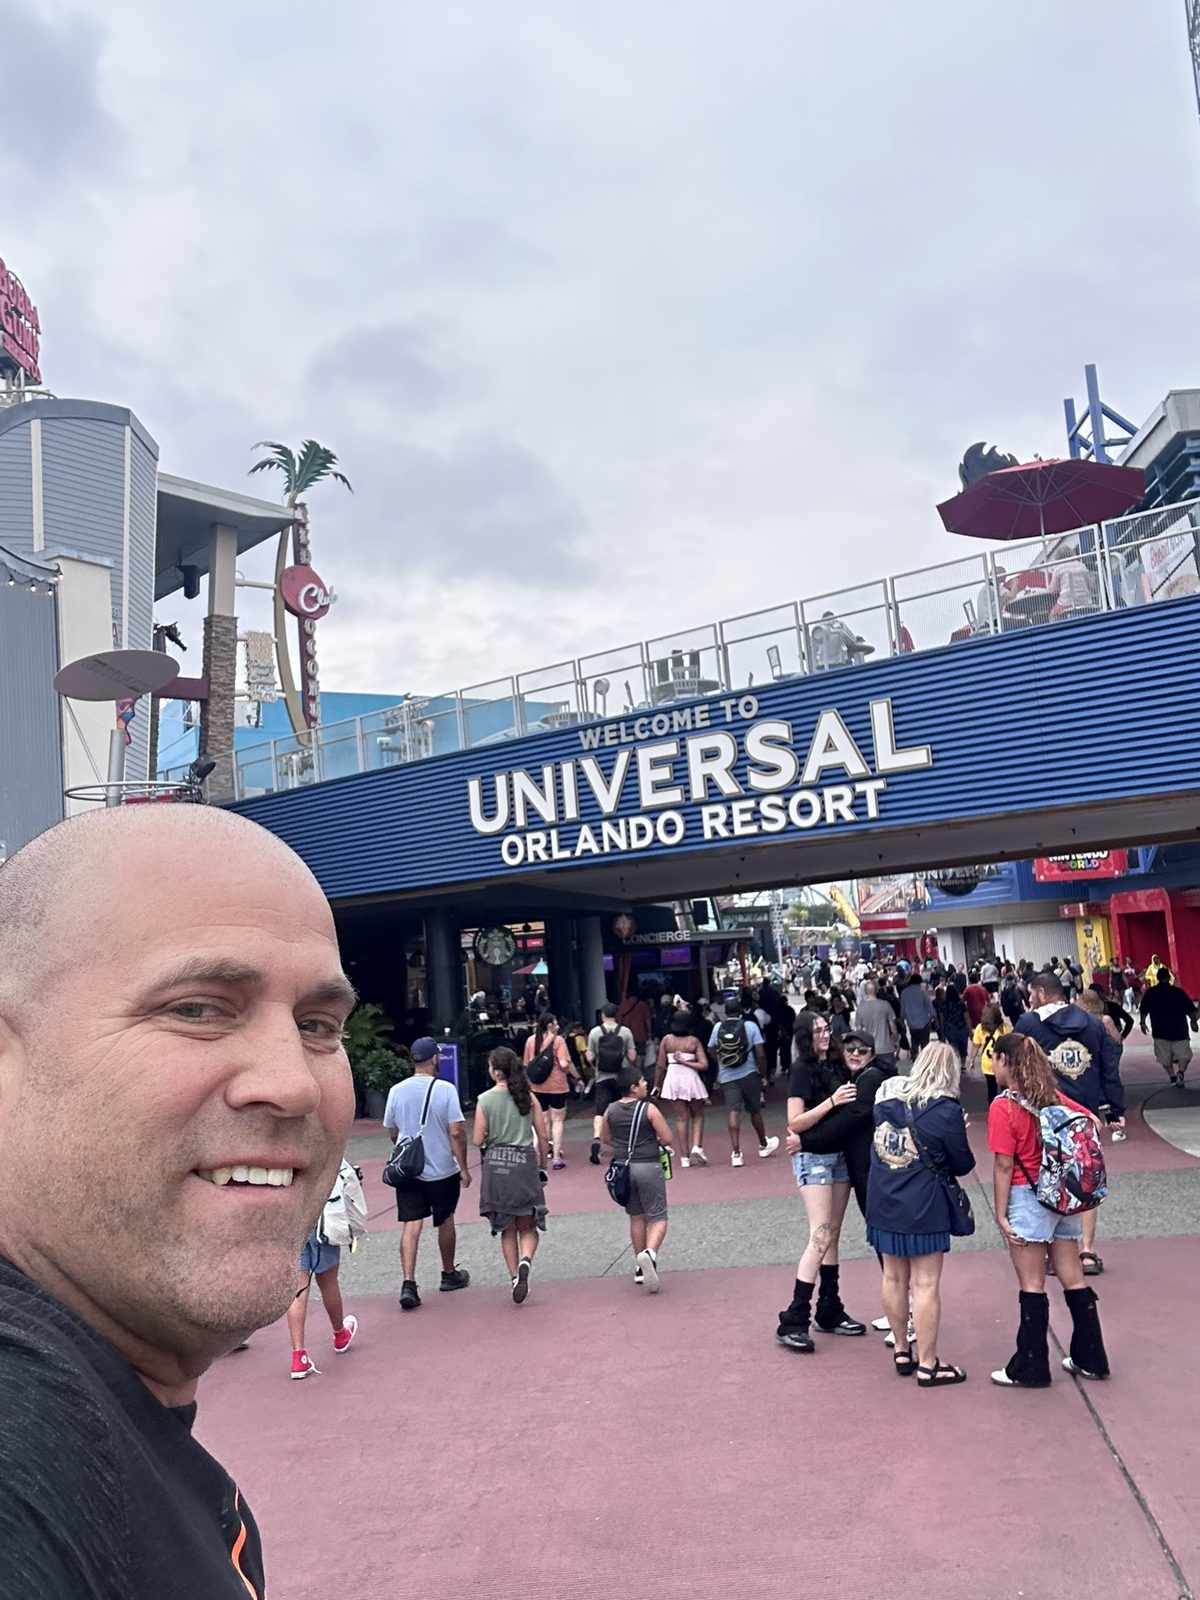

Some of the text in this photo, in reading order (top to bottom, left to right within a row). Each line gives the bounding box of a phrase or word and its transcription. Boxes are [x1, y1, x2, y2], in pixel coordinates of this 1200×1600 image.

[579, 695, 759, 750] WELCOME TO
[467, 698, 932, 835] UNIVERSAL
[501, 778, 887, 866] ORLANDO RESORT
[622, 930, 692, 944] CONCIERGE
